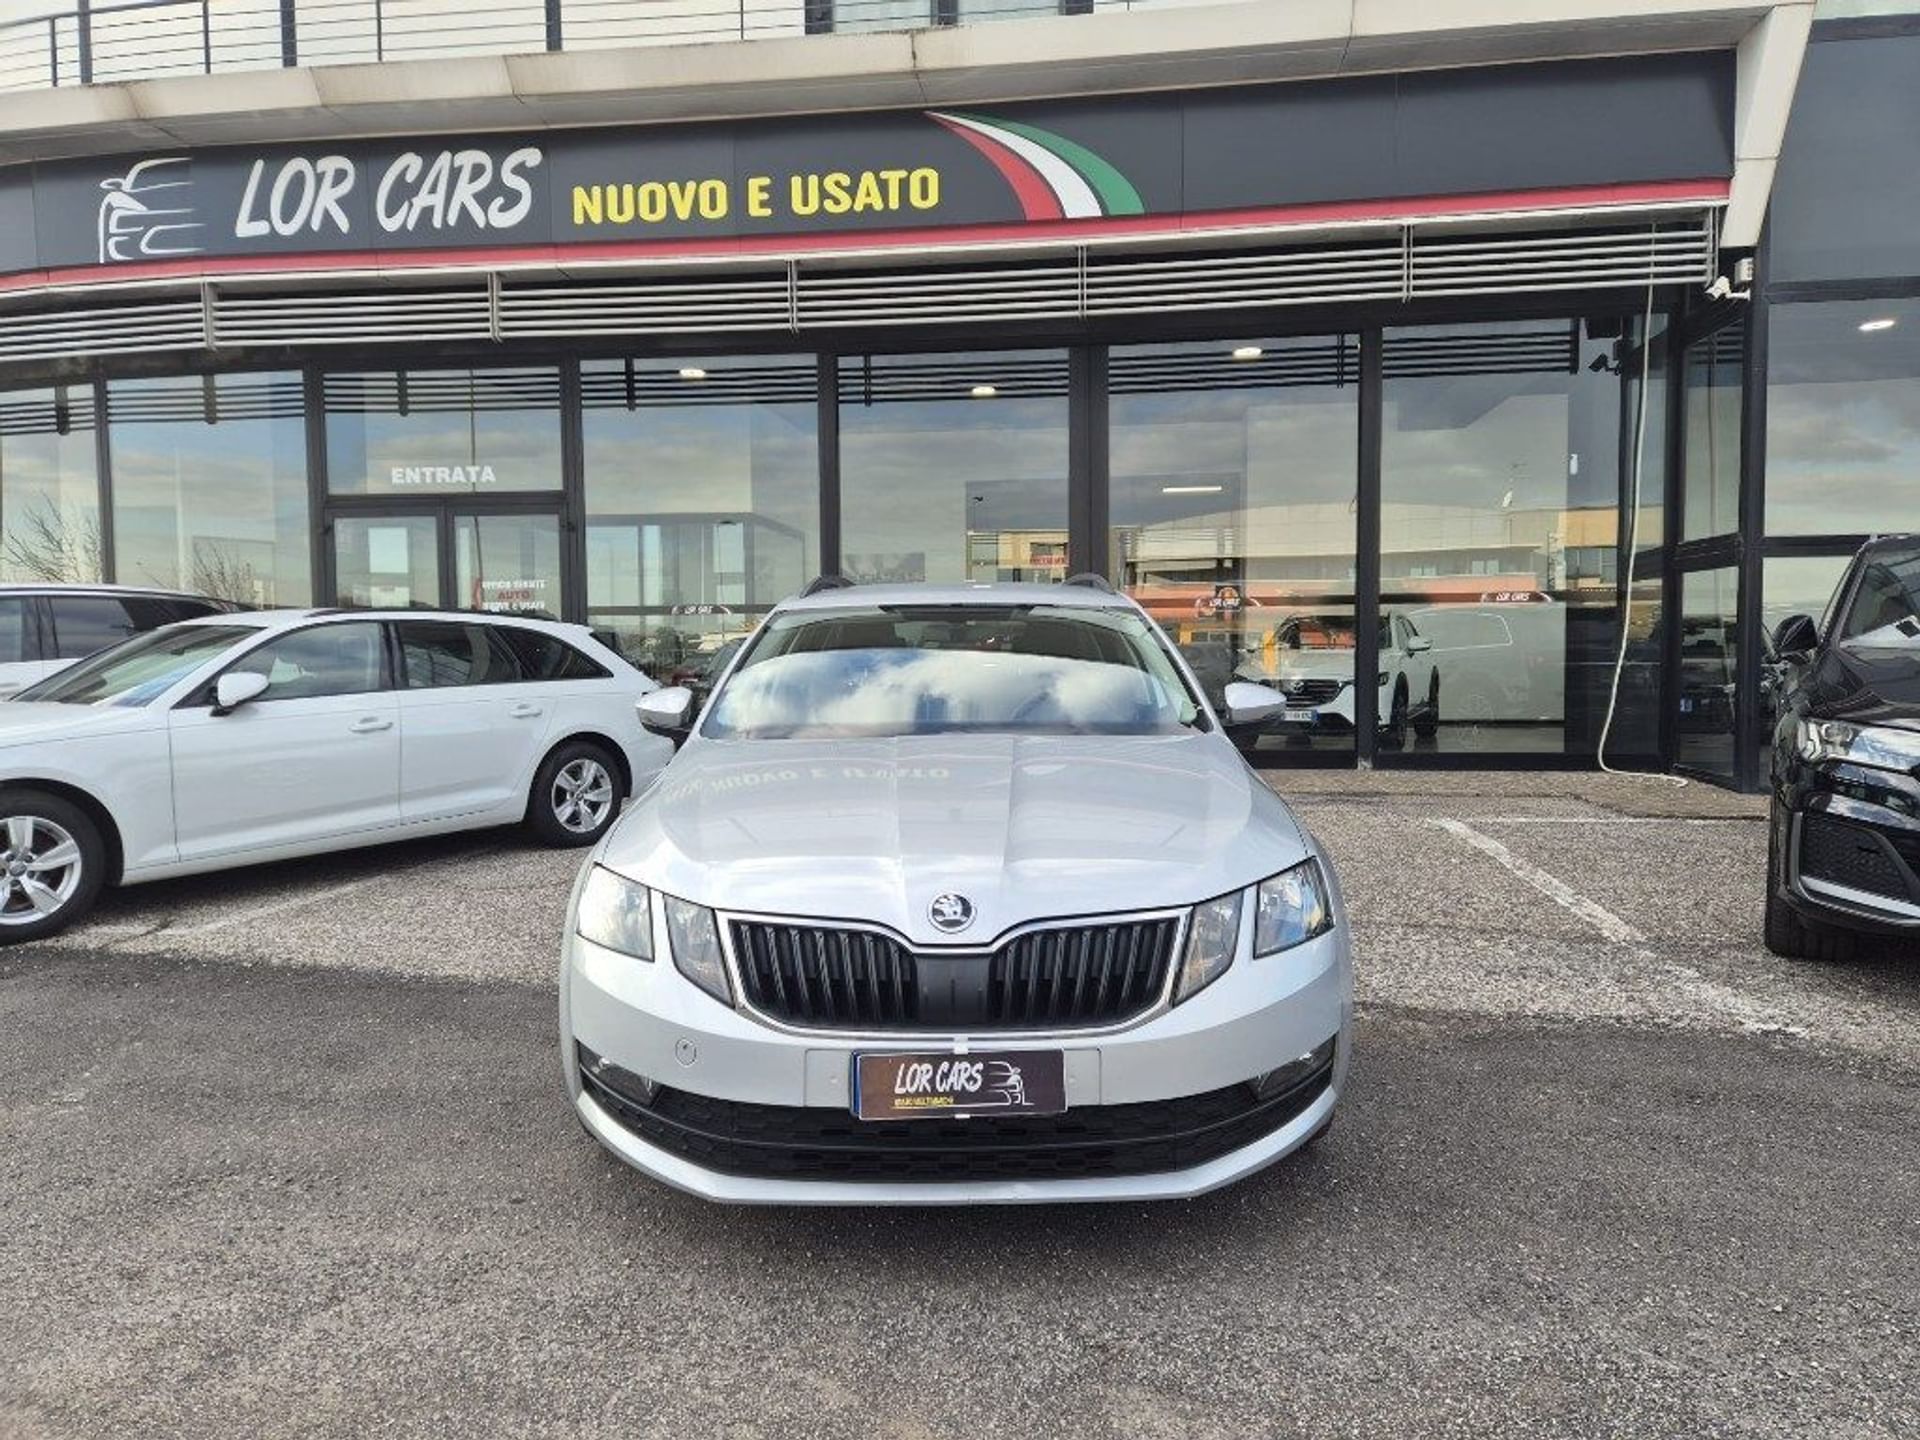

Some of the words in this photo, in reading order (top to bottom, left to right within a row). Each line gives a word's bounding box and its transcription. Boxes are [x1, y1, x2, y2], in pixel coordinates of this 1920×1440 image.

[235, 155, 356, 238] LOR
[375, 147, 543, 232] CARS
[572, 178, 728, 225] NUOVO
[747, 176, 772, 217] E
[790, 167, 940, 215] USATO
[391, 465, 496, 484] ENTRATA
[895, 1062, 933, 1094] LOR
[936, 1061, 983, 1092] CARS
